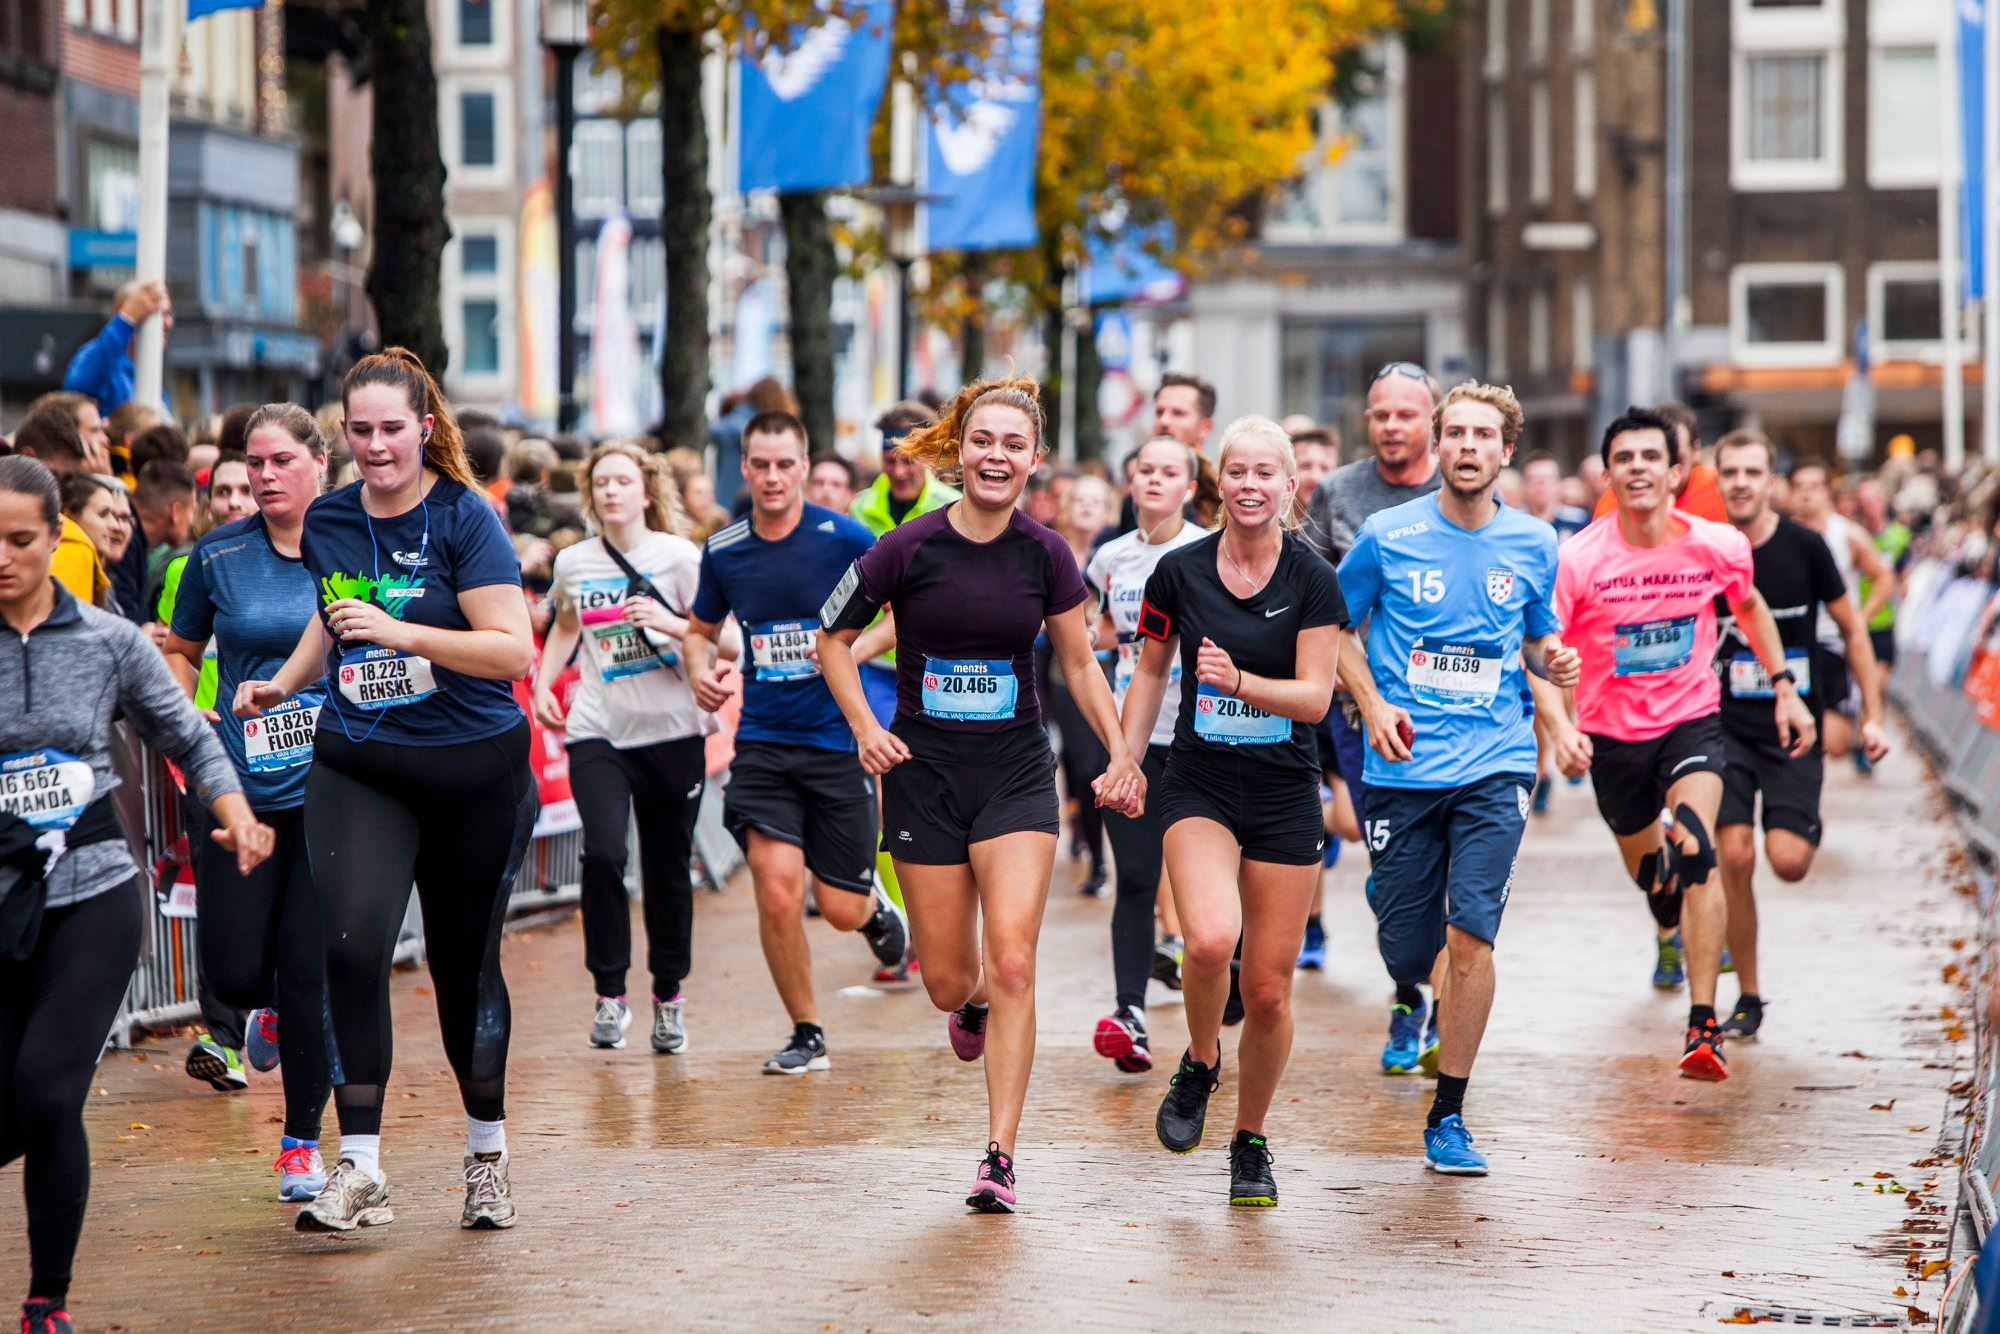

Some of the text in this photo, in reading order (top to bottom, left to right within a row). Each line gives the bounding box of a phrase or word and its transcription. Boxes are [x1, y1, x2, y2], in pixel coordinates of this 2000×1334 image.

[1387, 520, 1429, 540] SPROX
[1408, 569, 1446, 604] 15
[1643, 570, 1714, 586] MARATHON
[366, 648, 397, 660] menzis
[1442, 645, 1475, 656] menzis
[359, 660, 406, 682] 18.229
[954, 662, 988, 674] menzis
[1432, 656, 1480, 673] 18.639
[359, 678, 415, 702] RENSKE
[943, 676, 997, 694] 20.465
[269, 698, 301, 714] menzis
[964, 711, 1000, 719] GRONINGEN
[262, 710, 314, 735] 13.826
[268, 728, 314, 752] FLOOR
[0, 788, 73, 815] MANDA
[1365, 819, 1391, 851] 15
